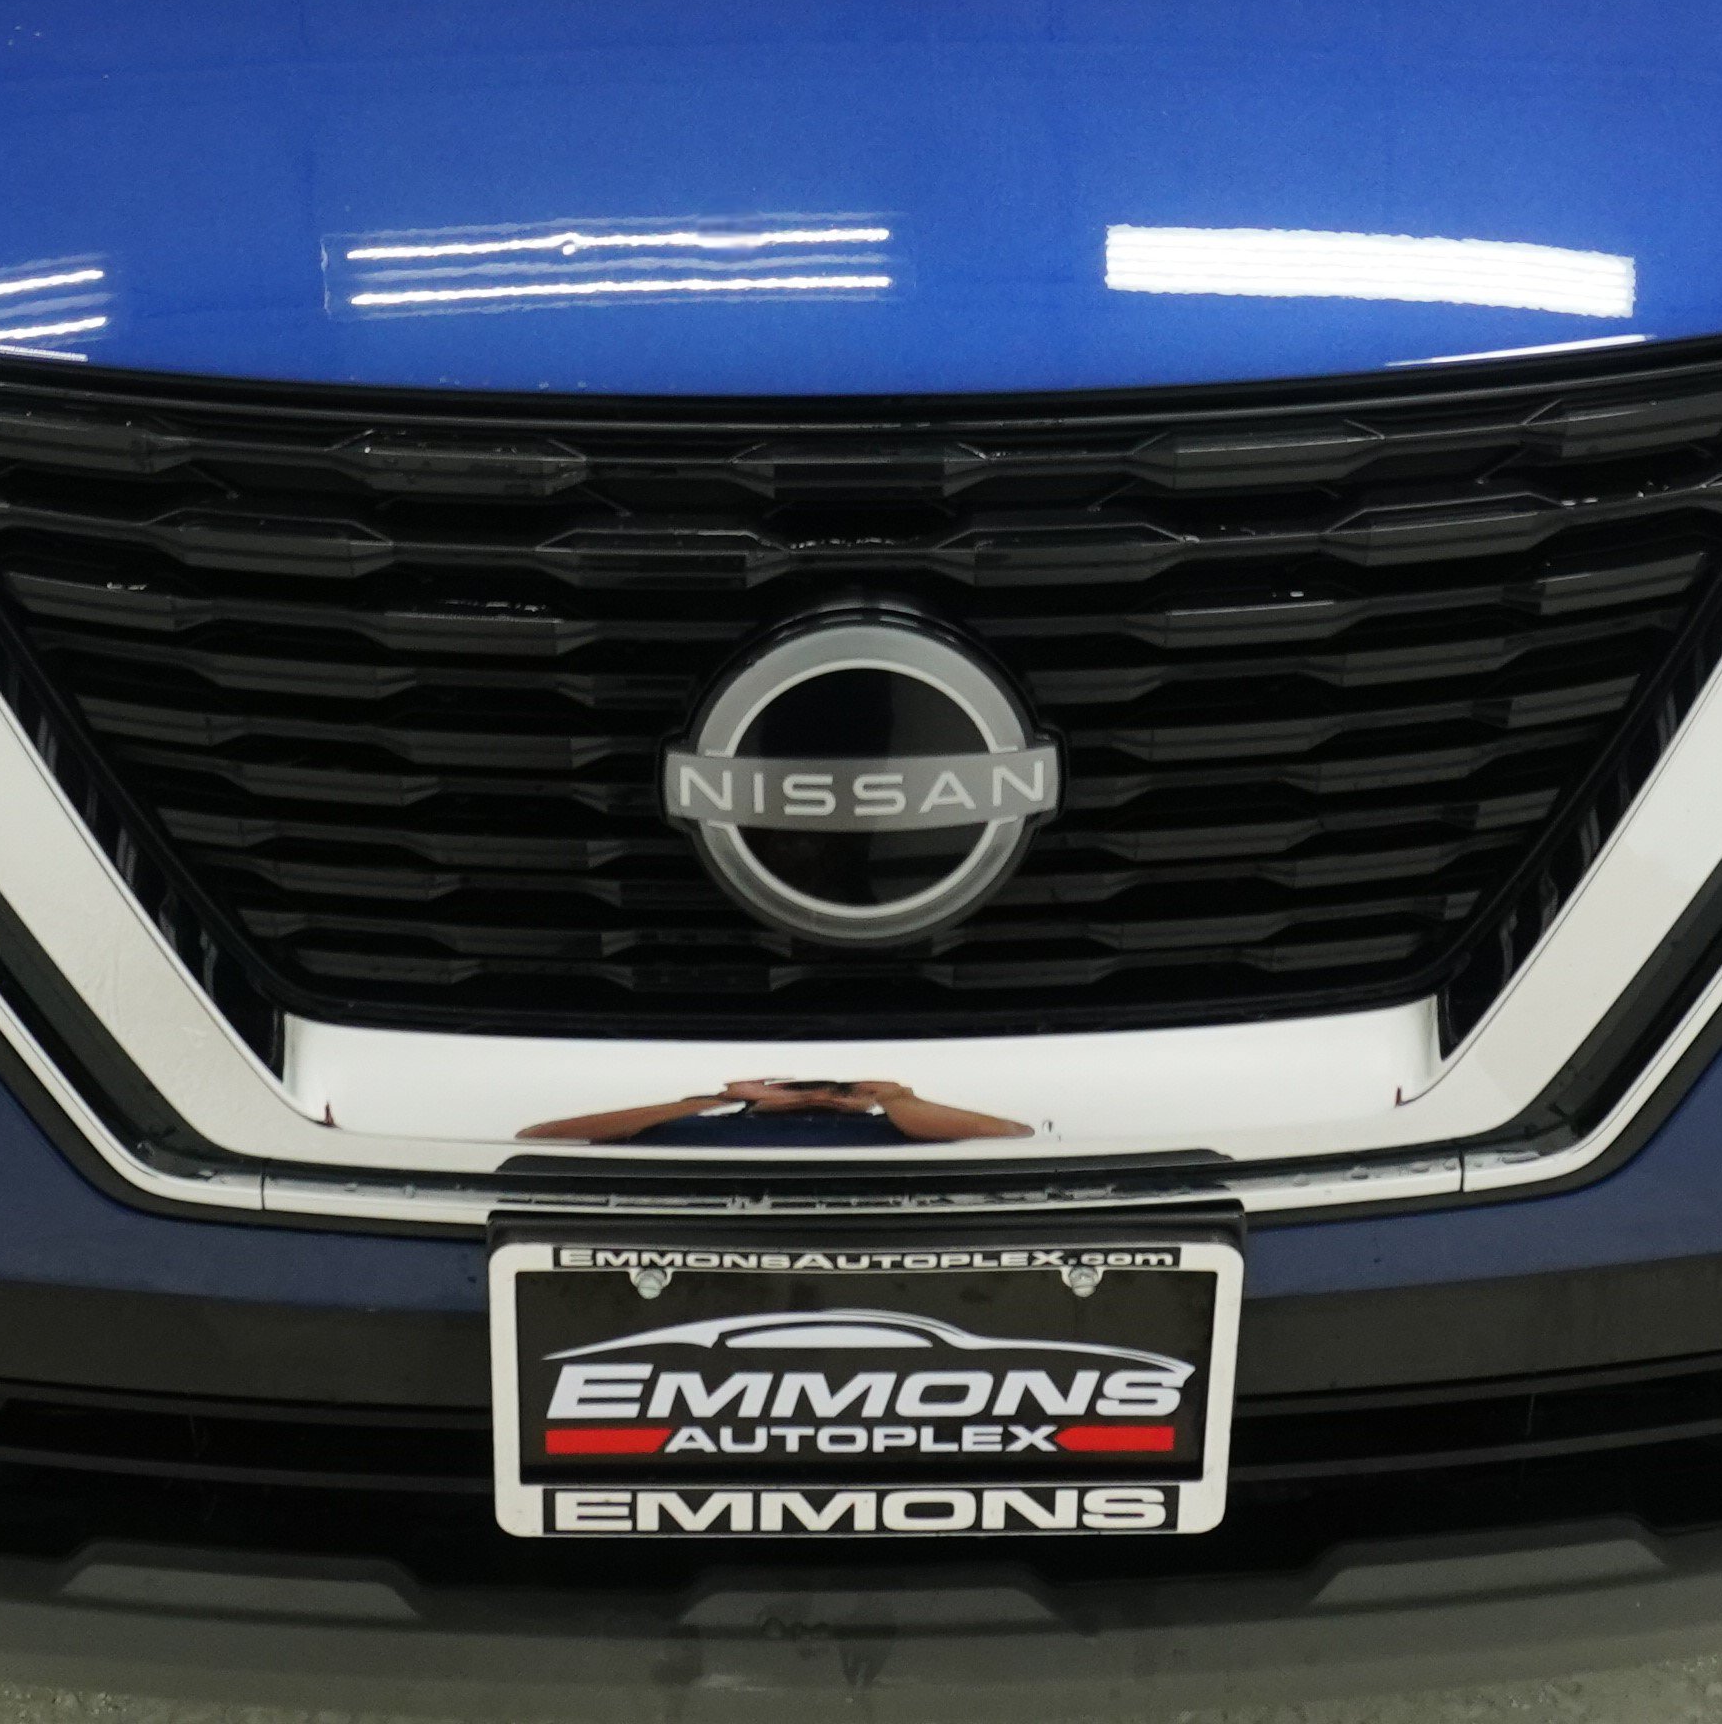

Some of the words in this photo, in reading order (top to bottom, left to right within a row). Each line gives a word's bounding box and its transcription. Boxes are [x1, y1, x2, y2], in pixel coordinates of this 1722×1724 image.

[679, 760, 1045, 817] NISSAN
[545, 1363, 1187, 1420] EMMONS
[663, 1425, 1059, 1454] AUTOPLEX
[552, 1488, 1167, 1533] EMMONS
